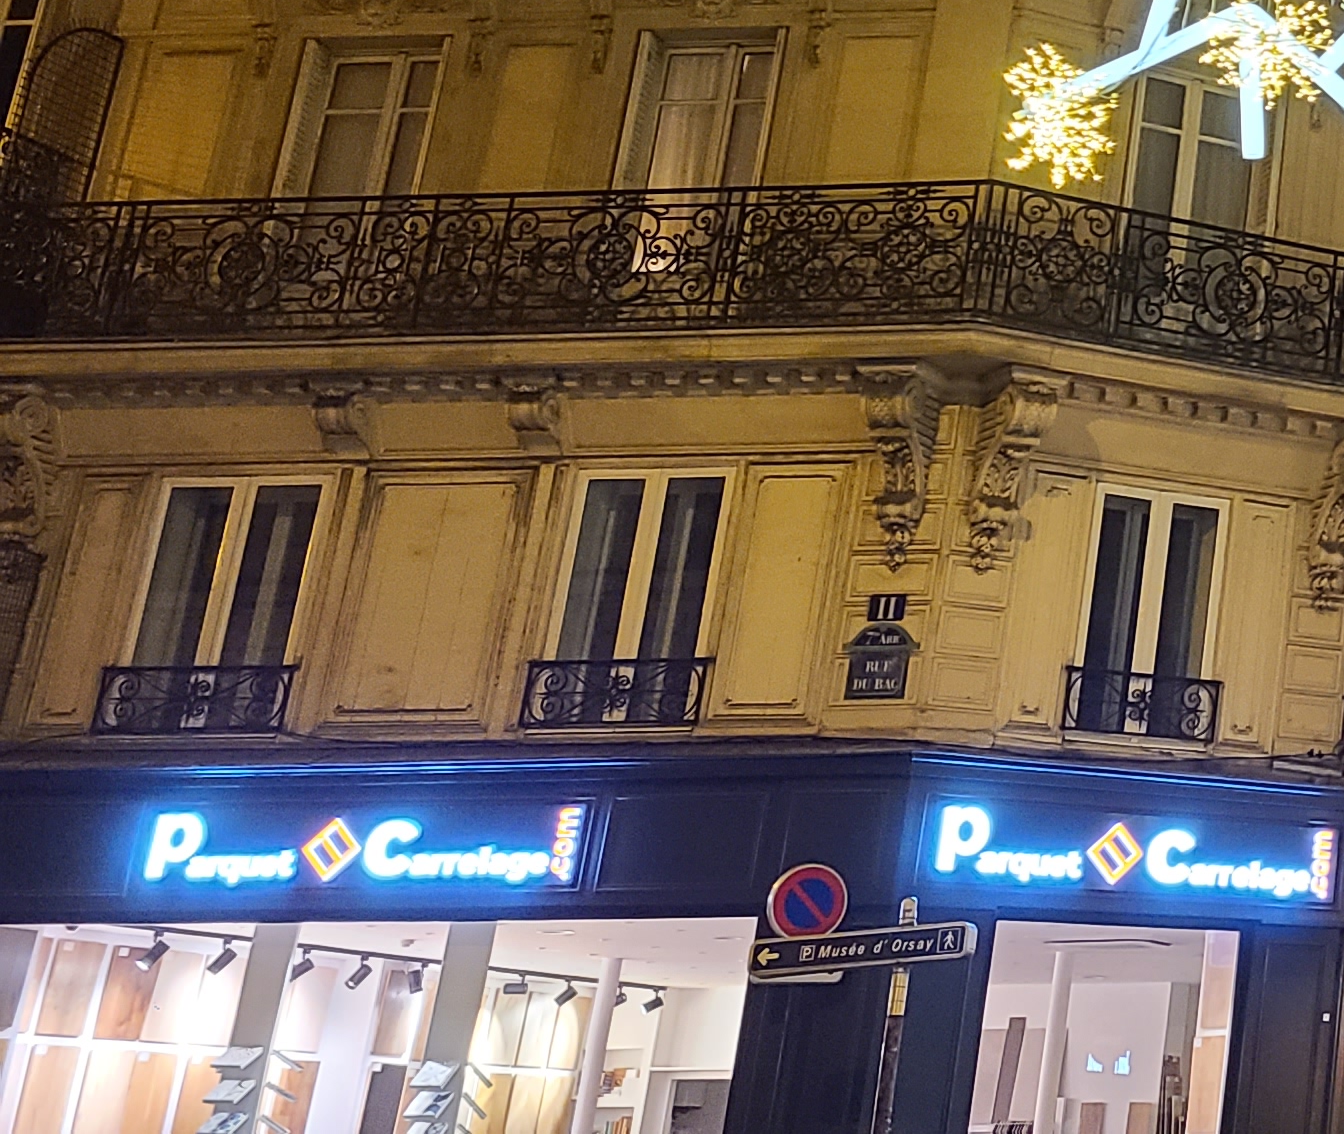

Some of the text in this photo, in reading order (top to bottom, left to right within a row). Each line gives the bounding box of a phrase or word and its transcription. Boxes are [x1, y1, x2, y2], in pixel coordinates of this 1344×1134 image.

[865, 660, 893, 673] RUE
[852, 678, 898, 690] DU BAC
[143, 810, 297, 886] Parquet
[363, 818, 551, 883] Carrelage
[934, 804, 1083, 883] Parquet
[1146, 828, 1311, 897] Carrelage
[818, 943, 865, 959] Musée
